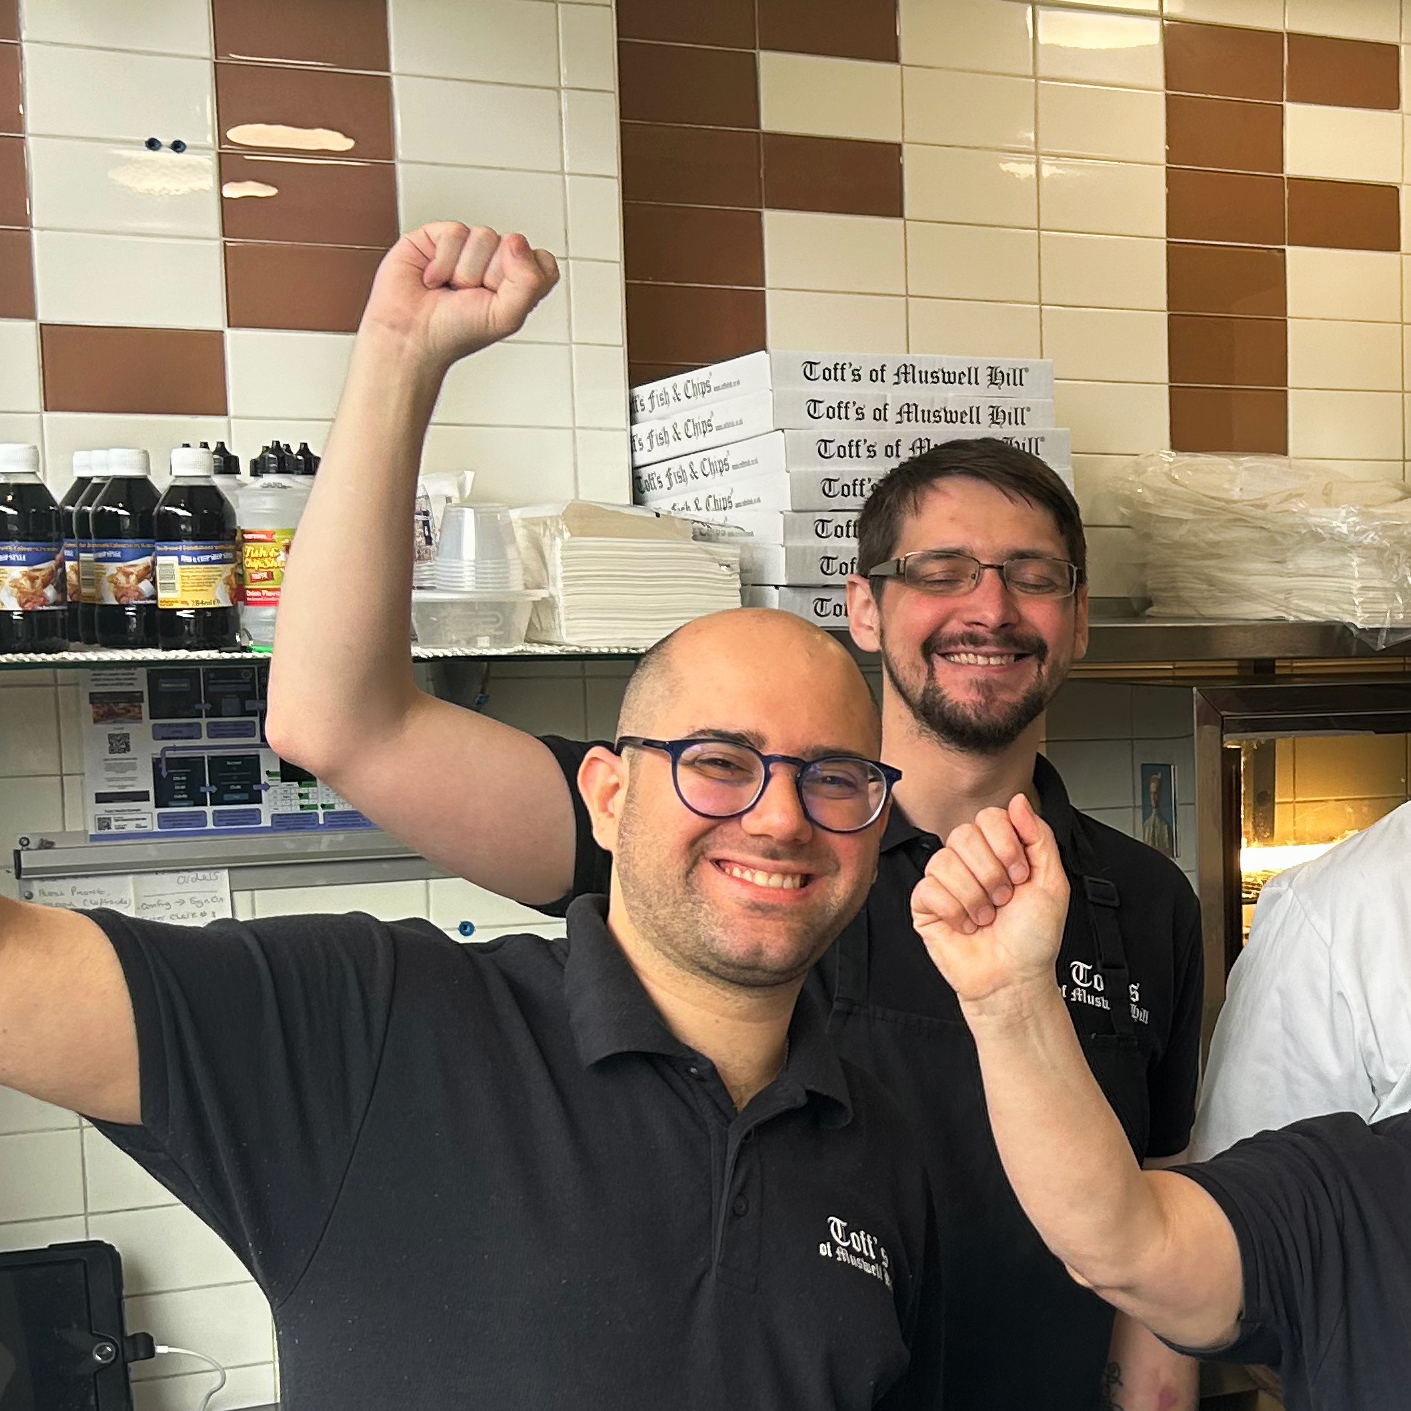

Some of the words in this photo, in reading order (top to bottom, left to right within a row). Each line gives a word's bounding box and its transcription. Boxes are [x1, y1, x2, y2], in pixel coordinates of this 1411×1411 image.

[801, 360, 862, 383] Toff's
[869, 364, 887, 384] of
[892, 363, 980, 386] Muswell
[648, 388, 670, 413] Fish
[672, 382, 681, 402] &
[684, 378, 712, 399] Chips
[805, 398, 865, 422] Toff's
[872, 402, 889, 423] of
[895, 402, 981, 426] Muswell
[647, 426, 670, 453] Fish
[672, 421, 682, 442] &
[684, 418, 714, 439] Chips
[816, 438, 877, 460] Toff's
[884, 438, 902, 458] of
[635, 470, 663, 495] Toff's
[666, 465, 688, 491] Fish
[689, 460, 699, 480] &
[700, 456, 730, 479] Chips
[827, 1216, 889, 1268] Toff's
[819, 1241, 833, 1258] of
[835, 1246, 883, 1281] Muswell
